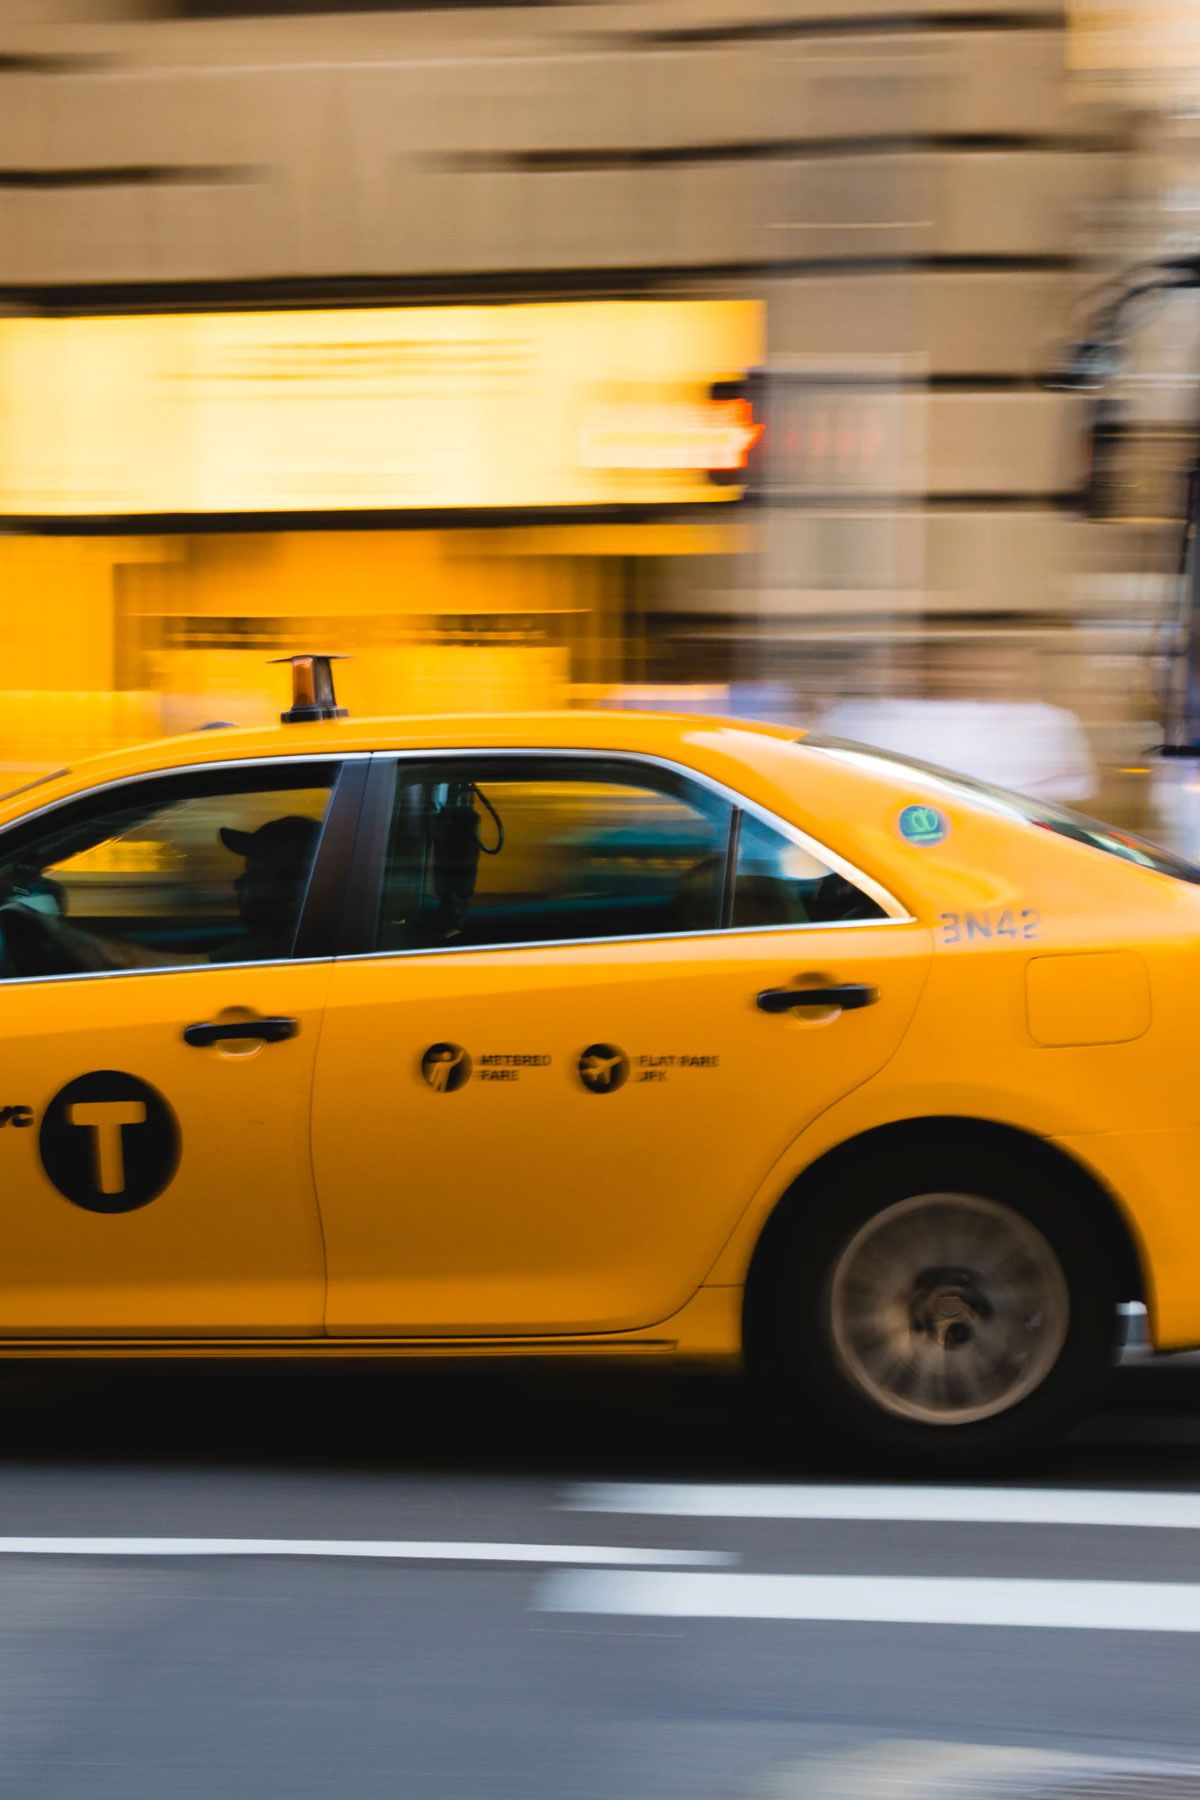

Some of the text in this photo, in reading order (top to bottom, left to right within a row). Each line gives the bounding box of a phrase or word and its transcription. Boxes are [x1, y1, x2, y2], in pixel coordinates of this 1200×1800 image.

[940, 908, 1041, 943] 3N42
[480, 1054, 552, 1067] METERED
[639, 1055, 719, 1067] FLAT FARE
[480, 1069, 519, 1082] FARE
[638, 1070, 668, 1082] JFK
[70, 1101, 147, 1194] T
